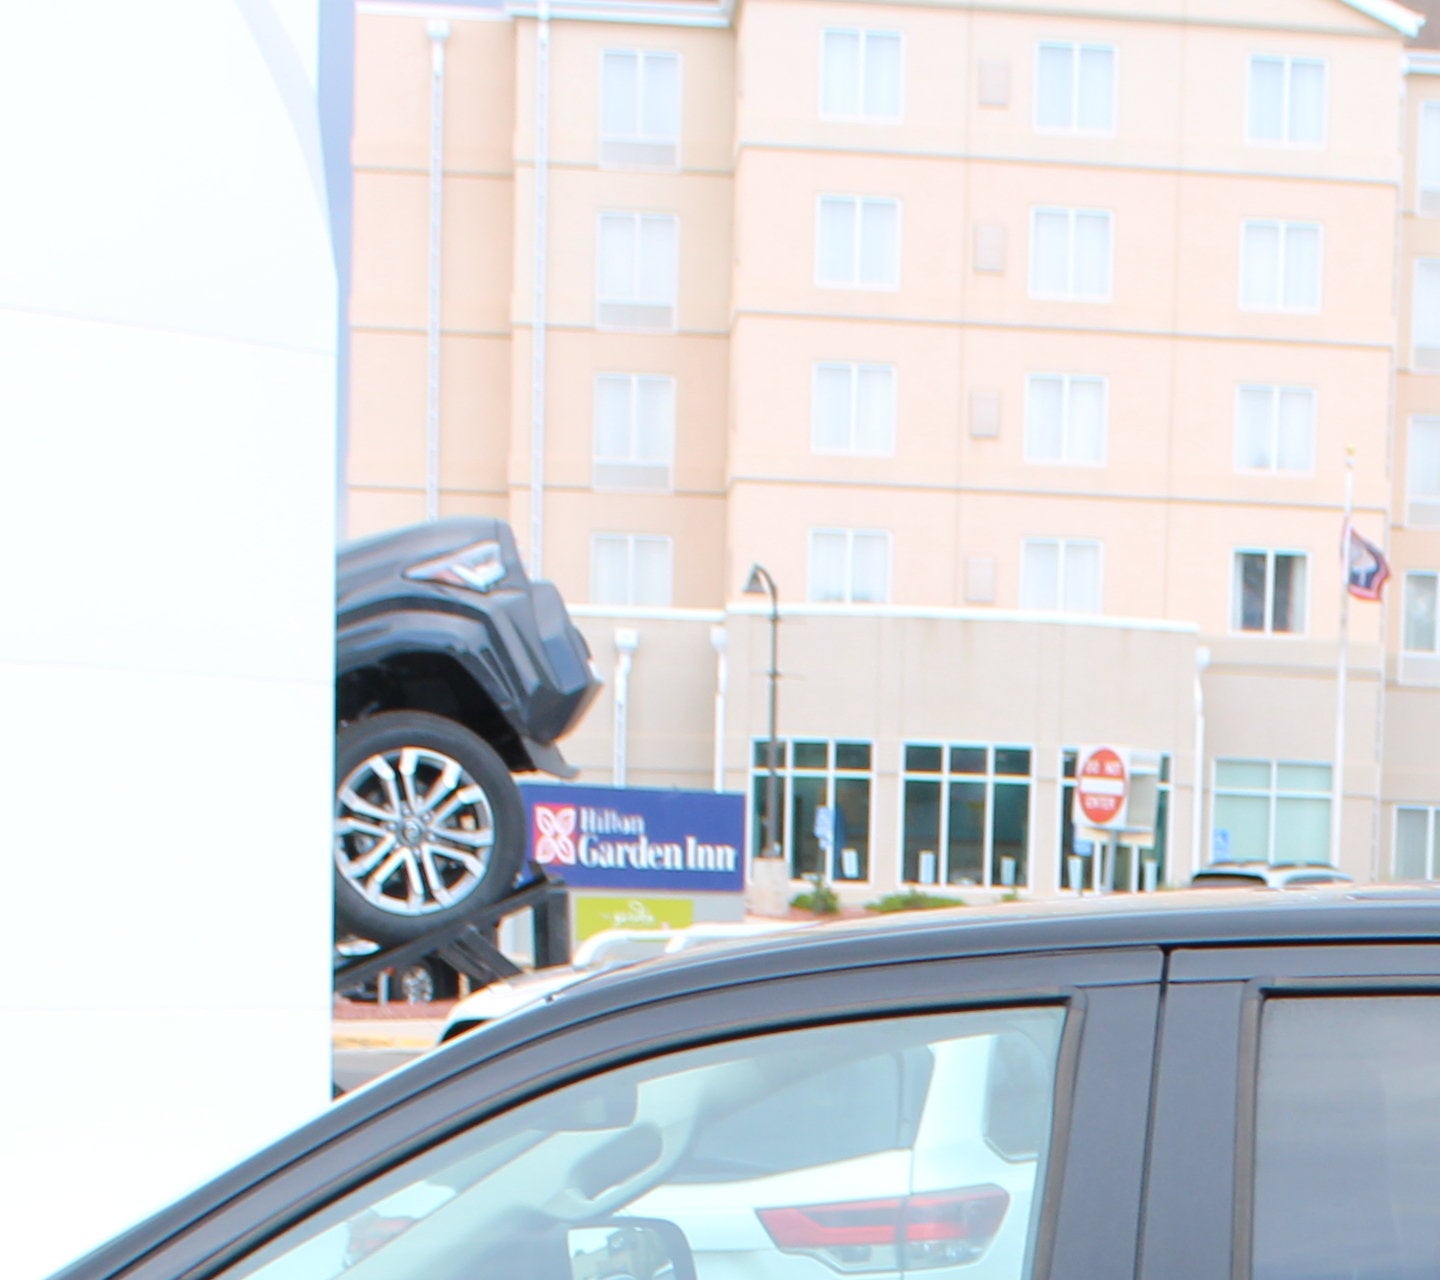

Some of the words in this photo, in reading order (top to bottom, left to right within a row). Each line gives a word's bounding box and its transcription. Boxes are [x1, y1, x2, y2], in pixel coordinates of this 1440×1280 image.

[579, 807, 646, 836] Hilton
[578, 833, 684, 871] Garden
[686, 836, 738, 872] Inn
